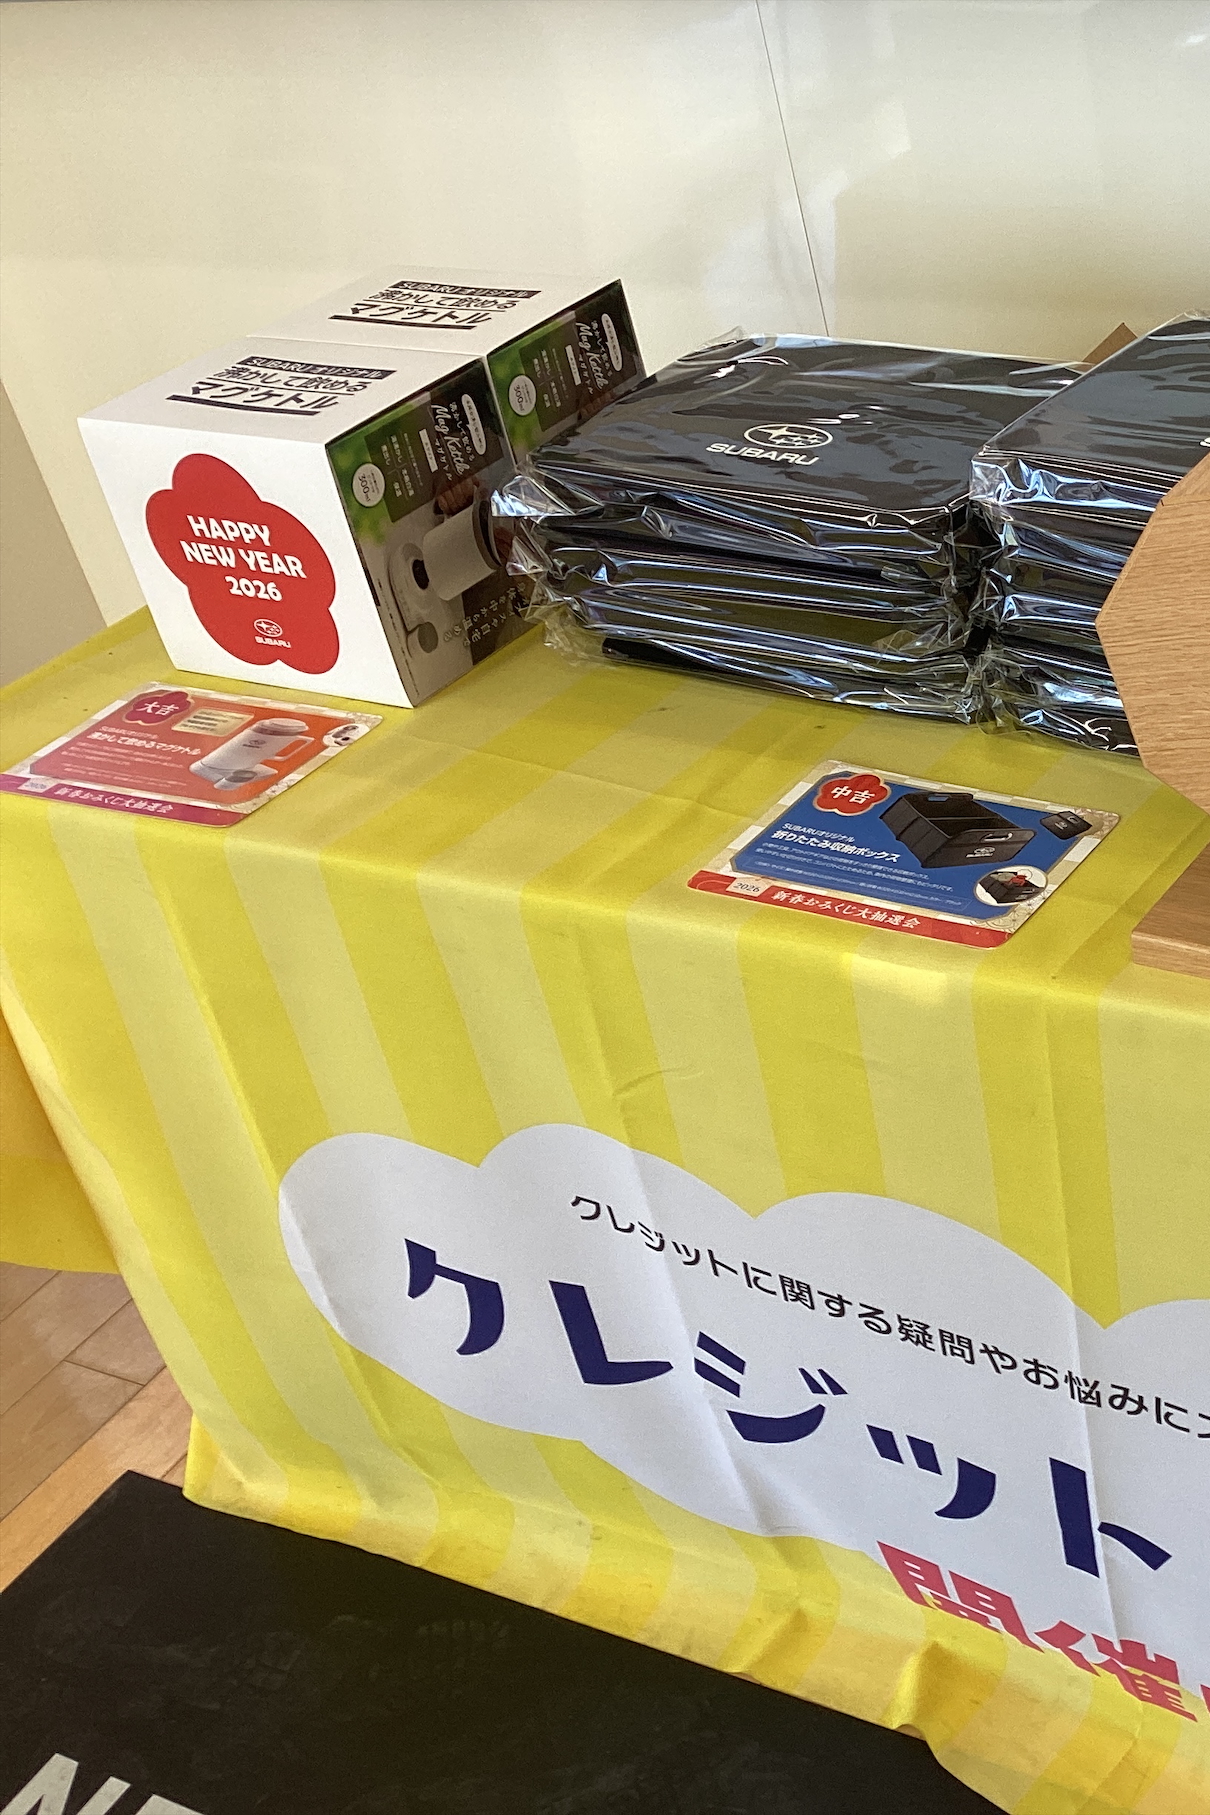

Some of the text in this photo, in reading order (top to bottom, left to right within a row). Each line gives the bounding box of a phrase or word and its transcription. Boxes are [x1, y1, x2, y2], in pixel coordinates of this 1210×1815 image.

[350, 303, 492, 324] マグケトル
[575, 322, 608, 391] Mug Kettle
[191, 381, 339, 409] マグケトル
[431, 404, 470, 475] Mug Kettle
[706, 442, 819, 466] SUBARU
[186, 514, 271, 547] HAPPY
[179, 540, 307, 578] NEW YEAR
[225, 576, 282, 602] 2026
[254, 636, 291, 649] SUBARU
[137, 700, 181, 717] 大吉
[831, 786, 875, 805] 中吉
[782, 822, 856, 843] SUBARUオリジナル
[771, 830, 901, 863] 折りたたみ収納ボックス
[733, 881, 762, 894] 2026
[771, 890, 921, 930] 新春おみくじ大抽選会
